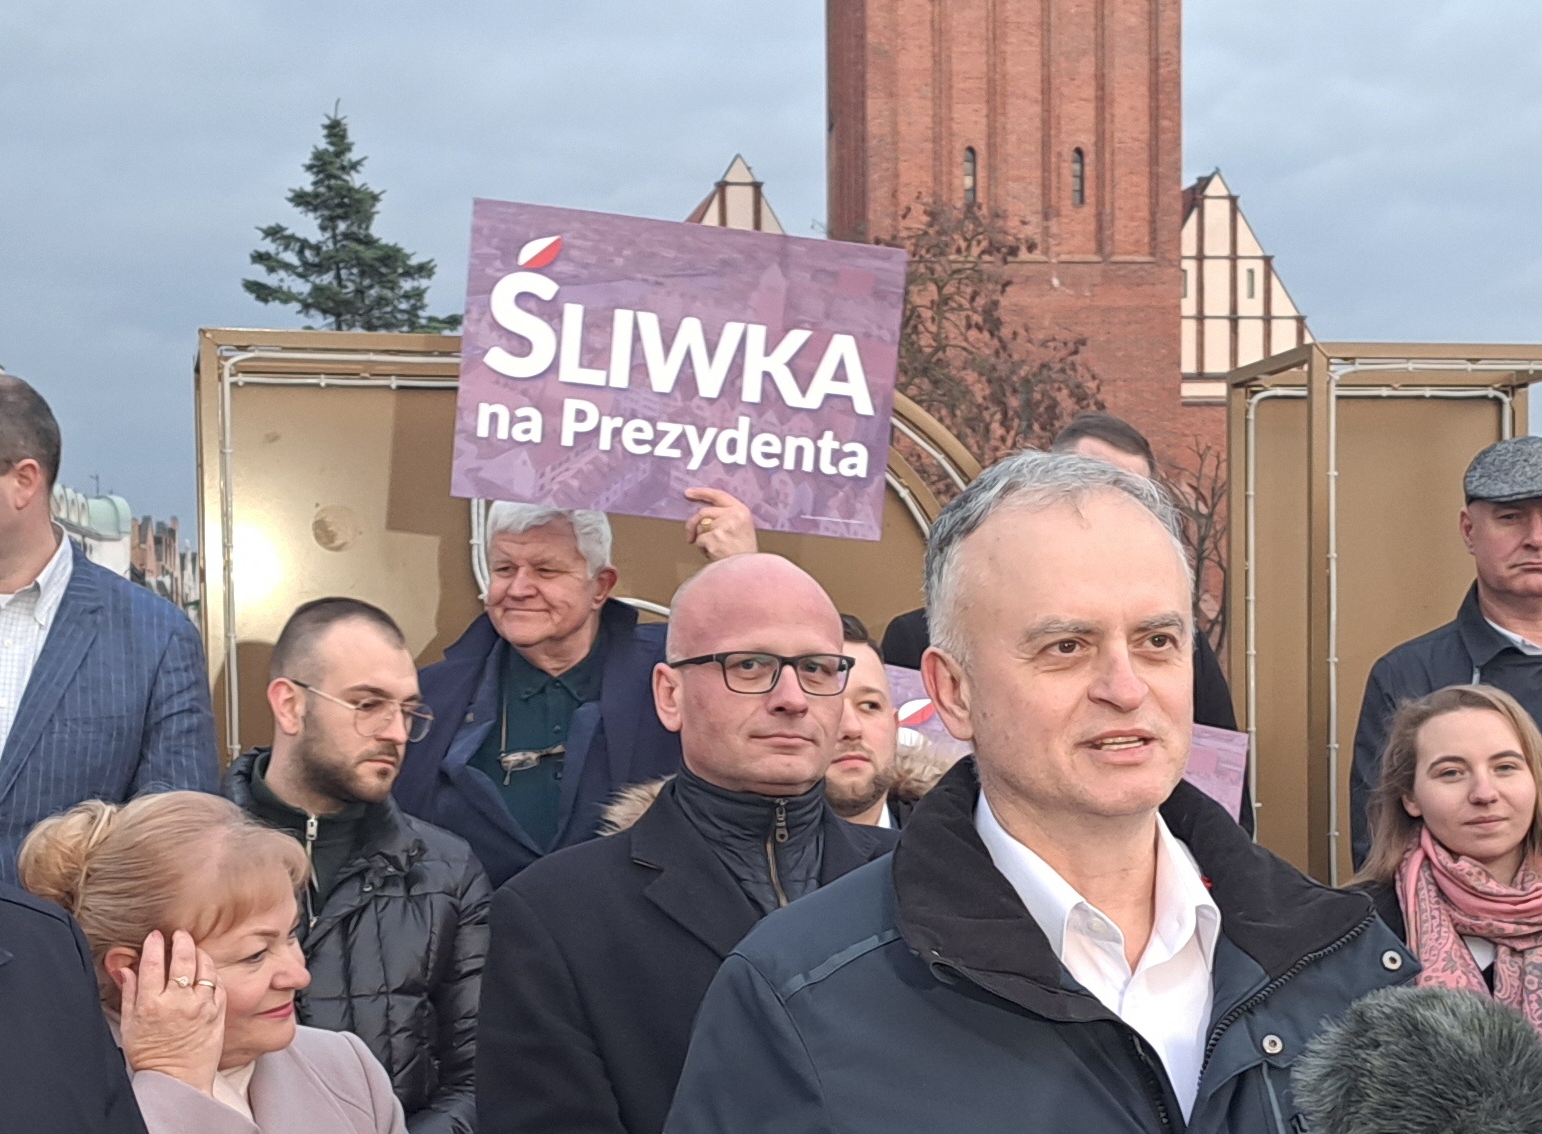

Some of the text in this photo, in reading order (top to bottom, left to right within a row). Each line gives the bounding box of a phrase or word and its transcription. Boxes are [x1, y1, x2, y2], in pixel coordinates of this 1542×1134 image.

[483, 235, 875, 416] ŚLIWKA
[476, 397, 869, 478] na Prezydenta
